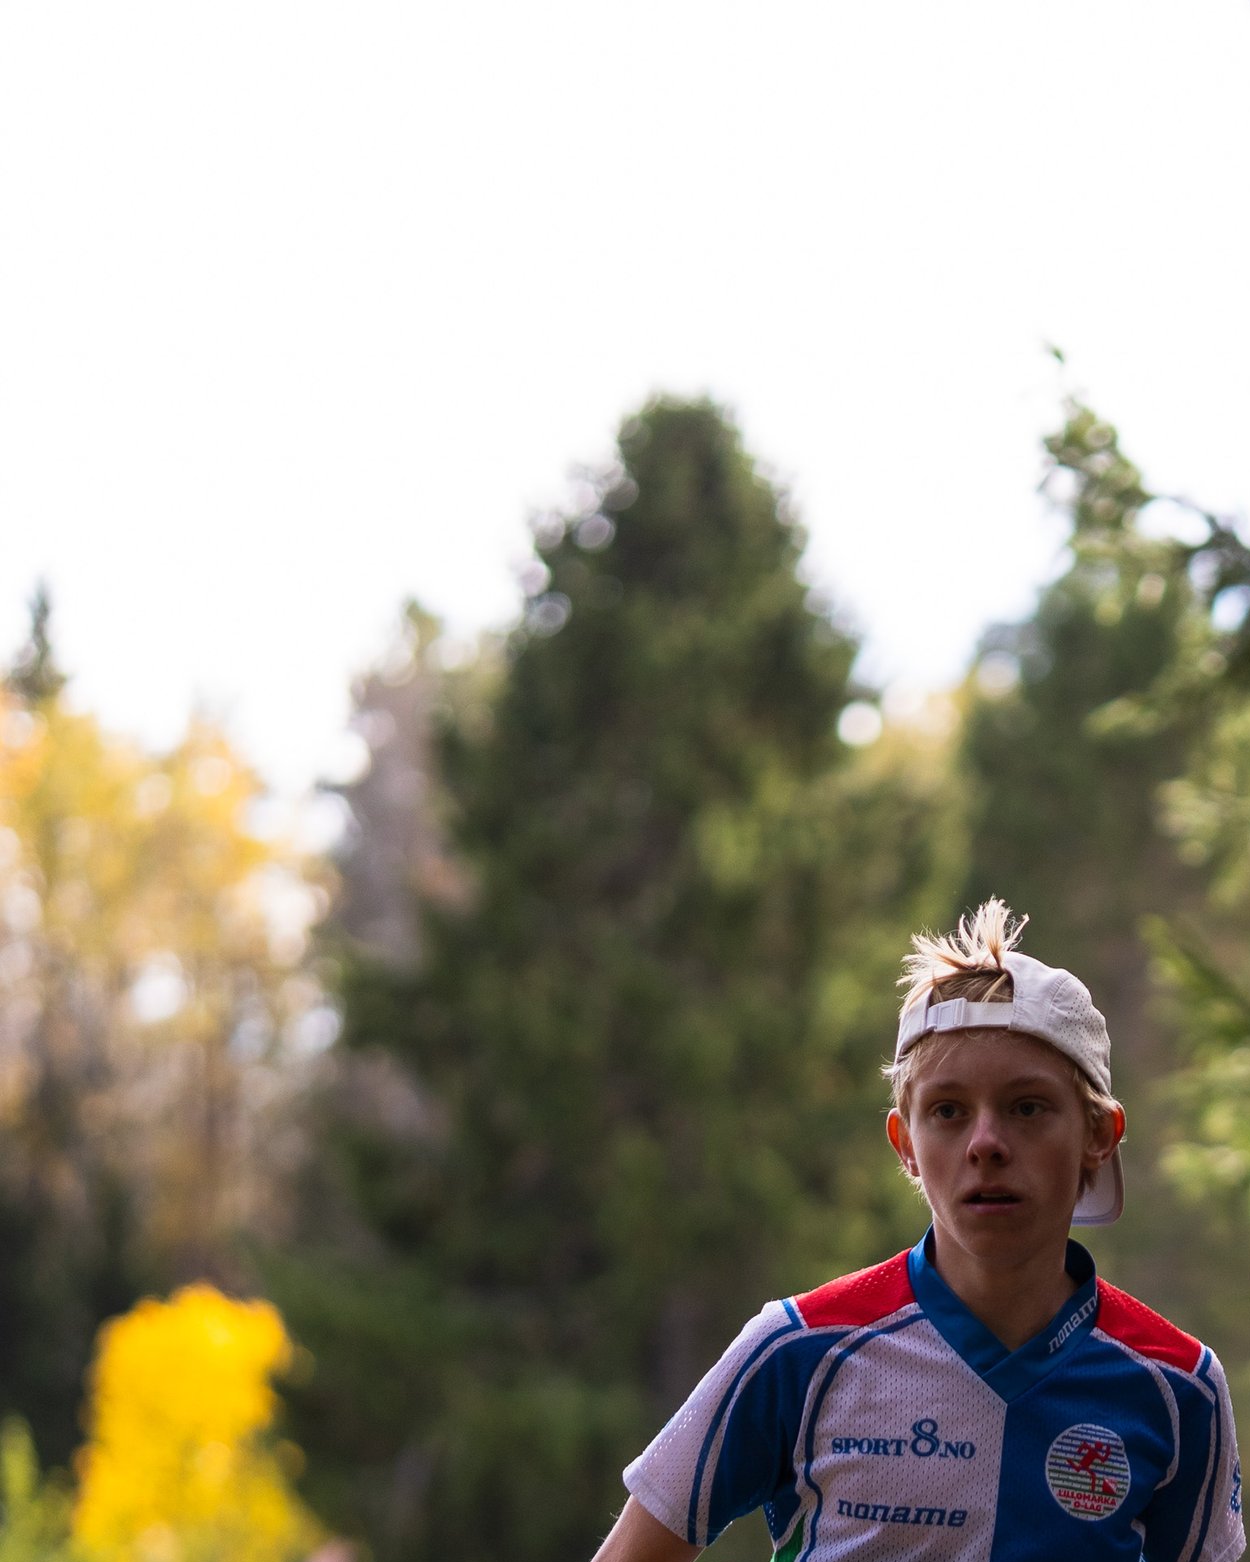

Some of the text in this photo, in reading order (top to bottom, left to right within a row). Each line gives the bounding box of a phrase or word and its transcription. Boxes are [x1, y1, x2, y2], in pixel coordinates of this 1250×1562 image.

[1048, 1296, 1098, 1354] nonam
[1057, 1489, 1117, 1506] LILLOMARKA
[837, 1499, 968, 1527] noname
